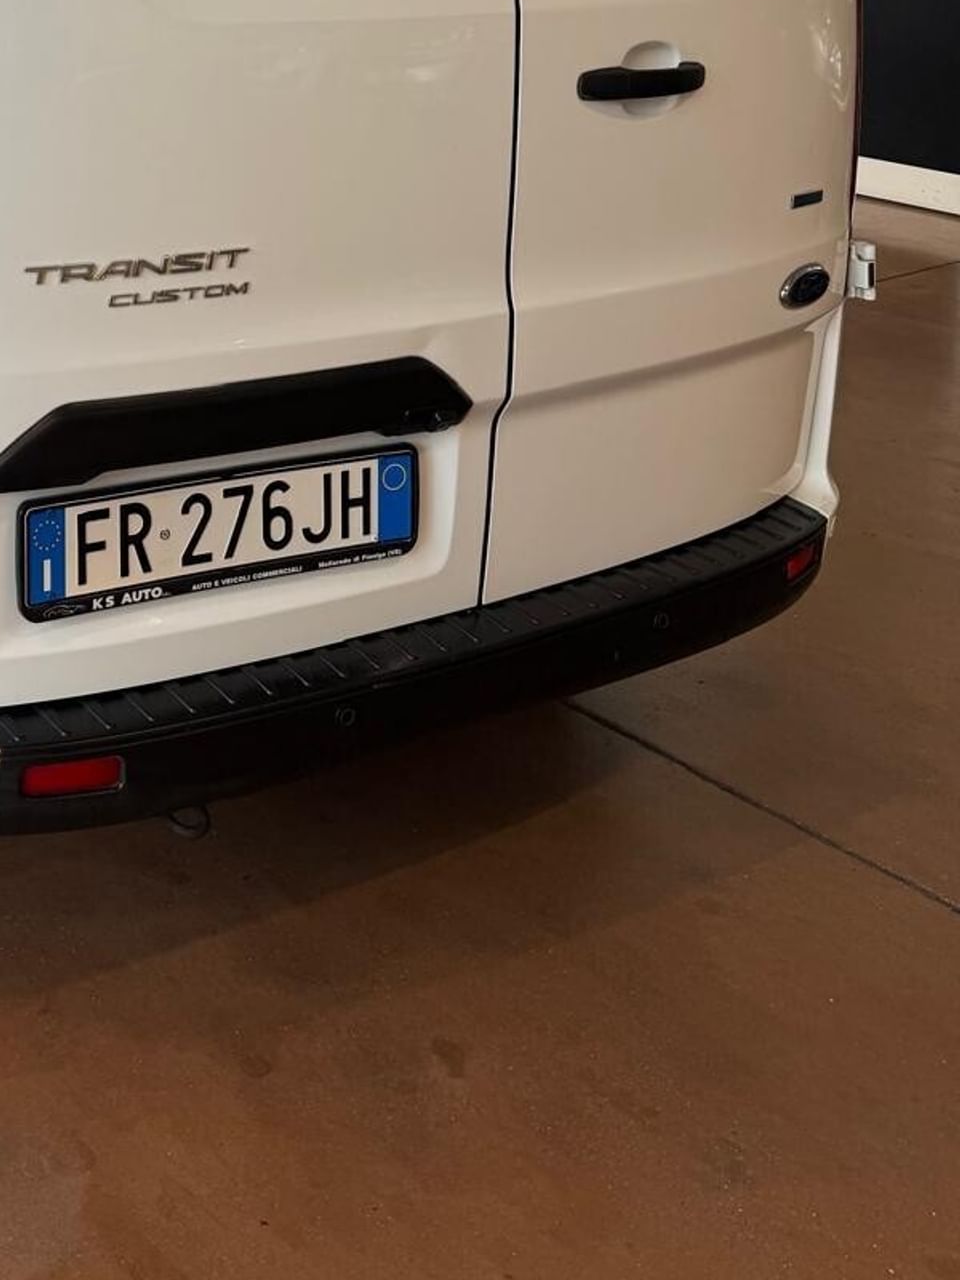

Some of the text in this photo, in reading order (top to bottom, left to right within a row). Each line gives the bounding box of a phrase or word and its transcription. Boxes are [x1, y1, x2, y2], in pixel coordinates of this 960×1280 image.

[23, 247, 250, 285] TRANSIT
[108, 282, 250, 308] CUSTOM
[77, 502, 152, 586] FR
[180, 466, 372, 567] 276JH
[191, 580, 213, 591] AUTO
[221, 574, 251, 586] VEICOLI
[252, 565, 303, 580] COMMERCIALI
[121, 586, 163, 605] AUTO
